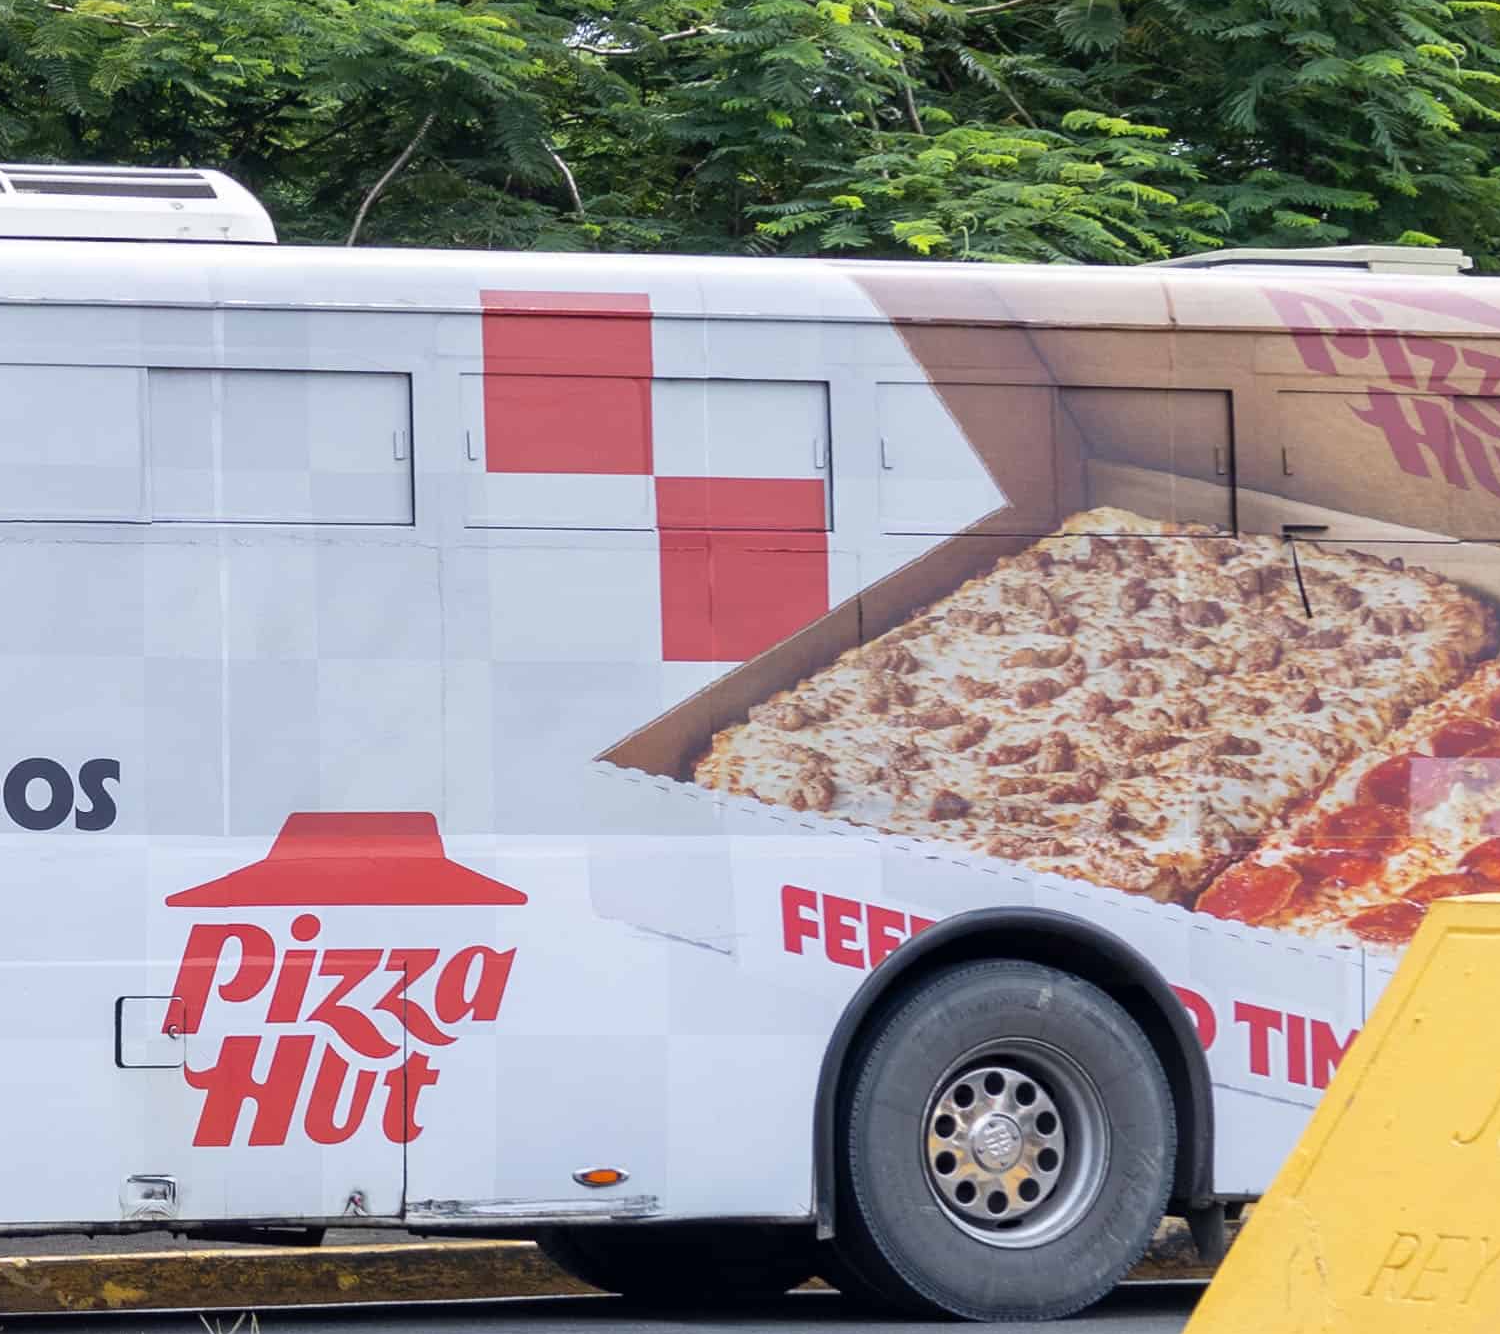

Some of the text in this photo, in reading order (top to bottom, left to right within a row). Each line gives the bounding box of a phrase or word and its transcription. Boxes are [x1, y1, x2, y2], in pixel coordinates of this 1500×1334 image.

[780, 883, 940, 971] FEE
[161, 913, 518, 1060] Pizza
[183, 1033, 441, 1148] Hut
[1234, 1000, 1368, 1091] TIM
